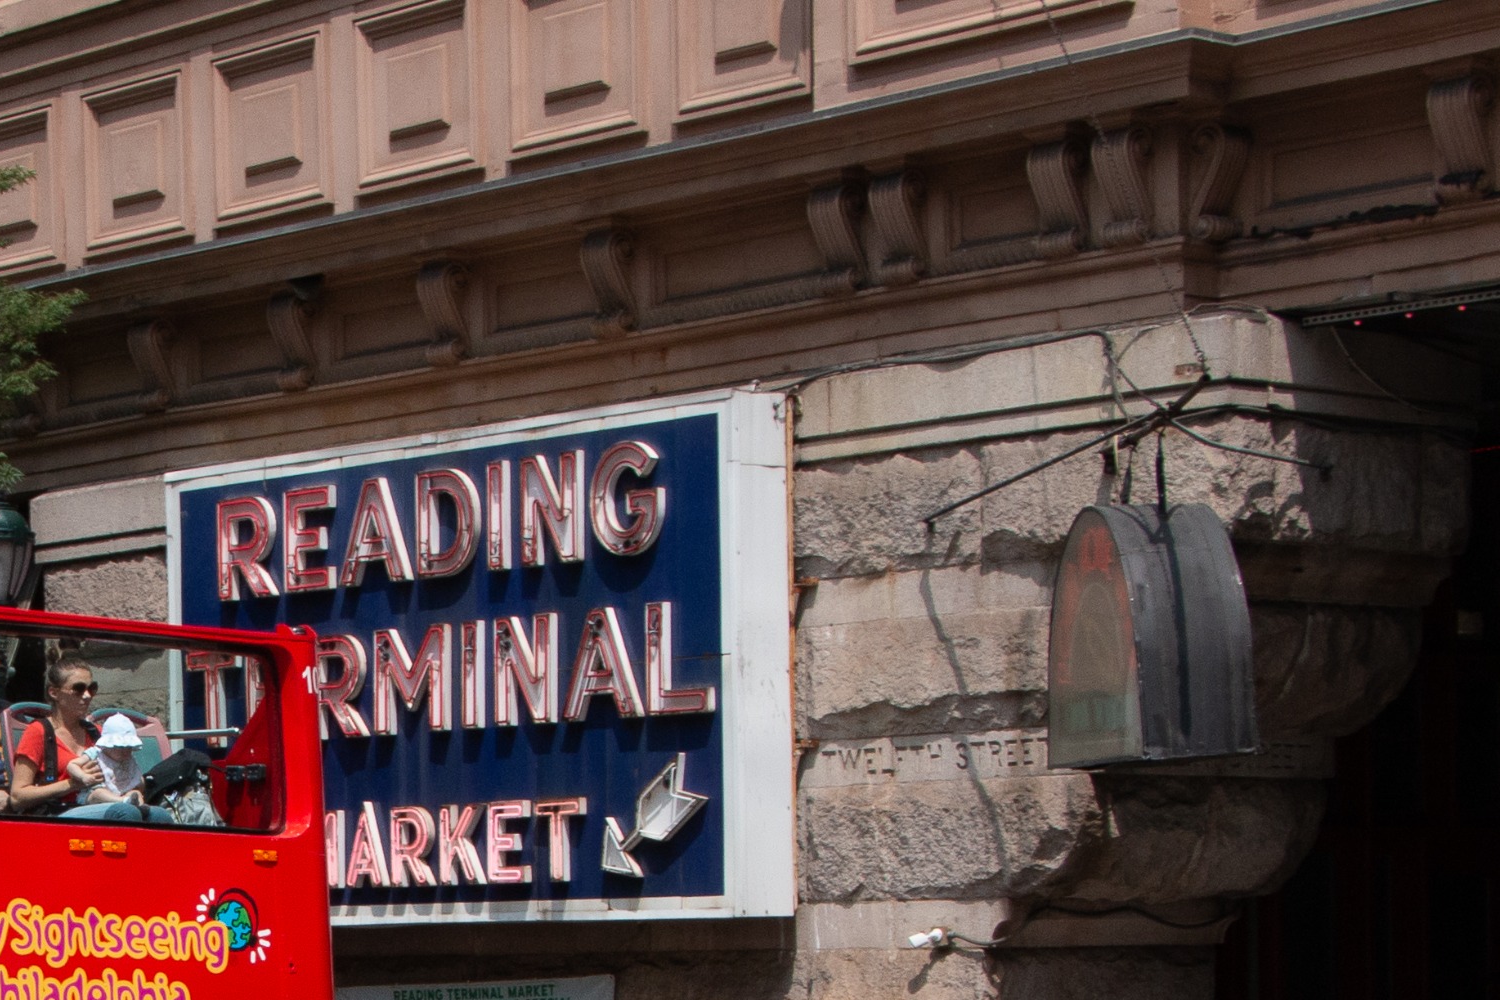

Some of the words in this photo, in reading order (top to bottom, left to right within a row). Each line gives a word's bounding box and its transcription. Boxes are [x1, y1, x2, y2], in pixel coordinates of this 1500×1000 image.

[215, 440, 668, 602] READING
[821, 743, 943, 775] TWELFTH
[955, 737, 1048, 770] STREET
[446, 986, 504, 1000] TERMINAL
[507, 984, 555, 998] MARKET
